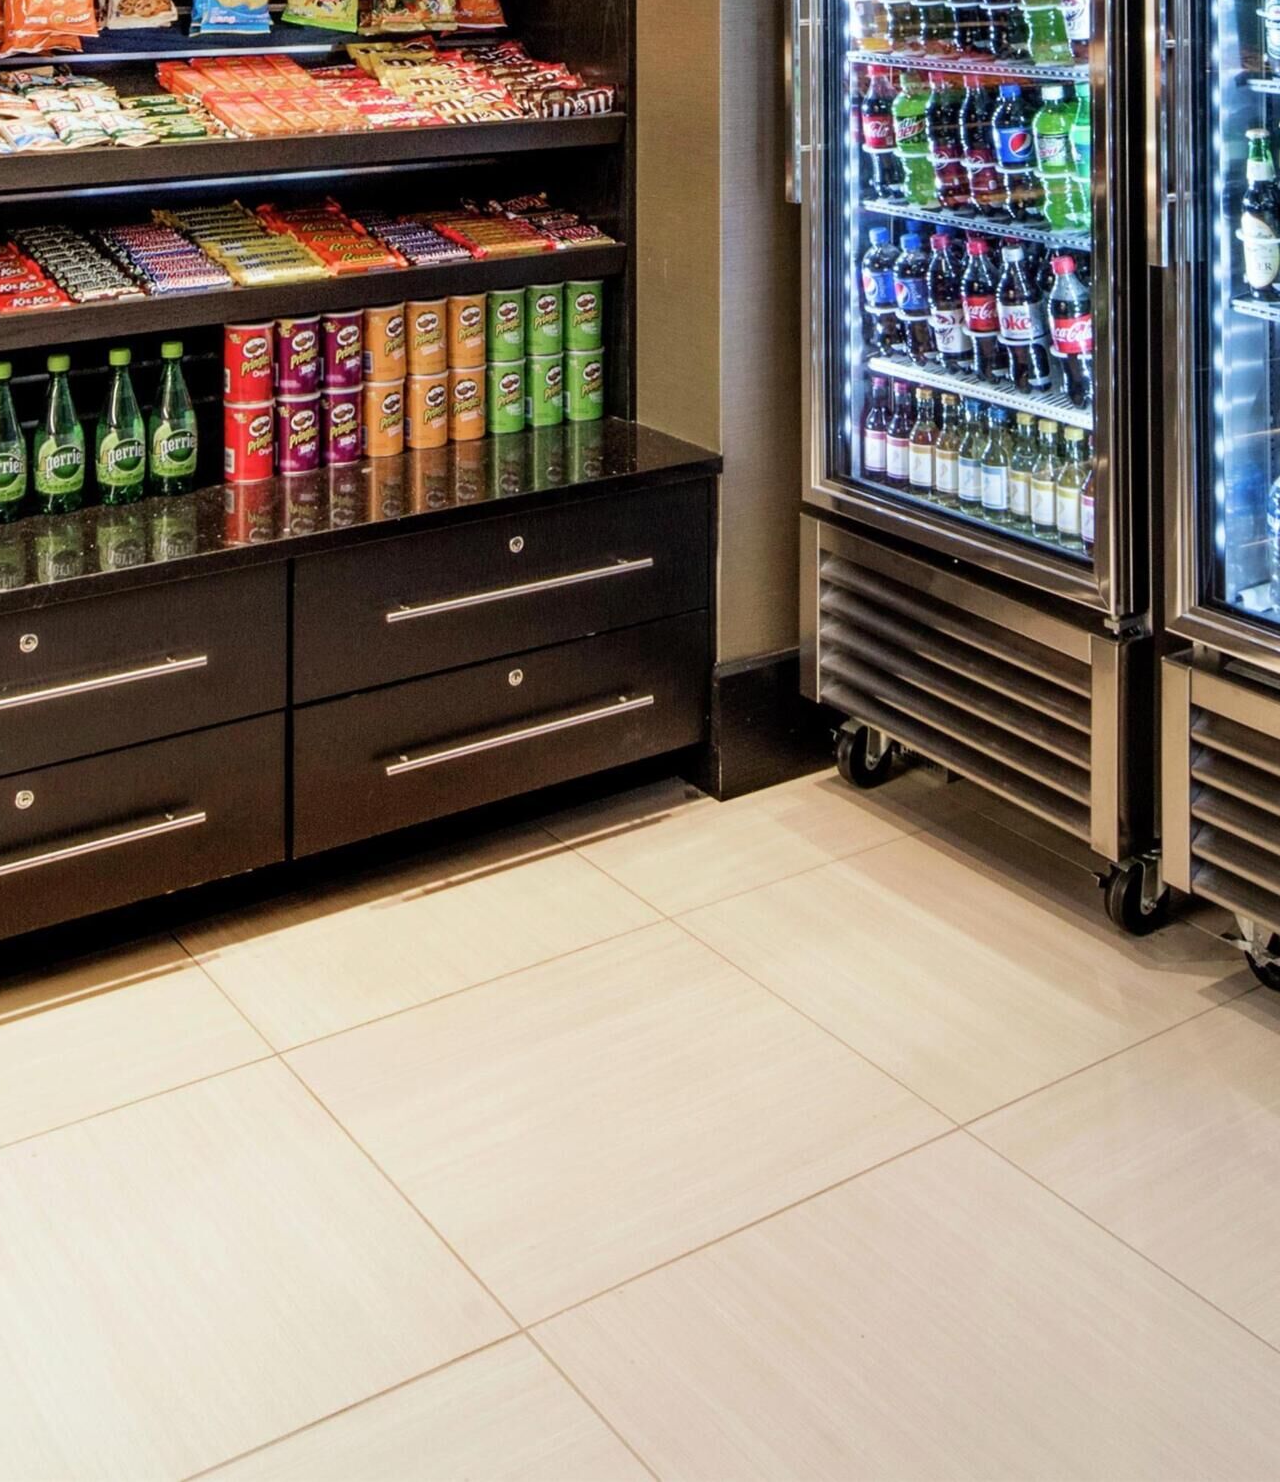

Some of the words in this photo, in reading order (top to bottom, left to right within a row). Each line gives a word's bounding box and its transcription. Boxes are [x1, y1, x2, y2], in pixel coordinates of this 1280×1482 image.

[45, 450, 83, 473] perrie
[107, 438, 146, 466] perrie
[160, 433, 197, 464] perrie
